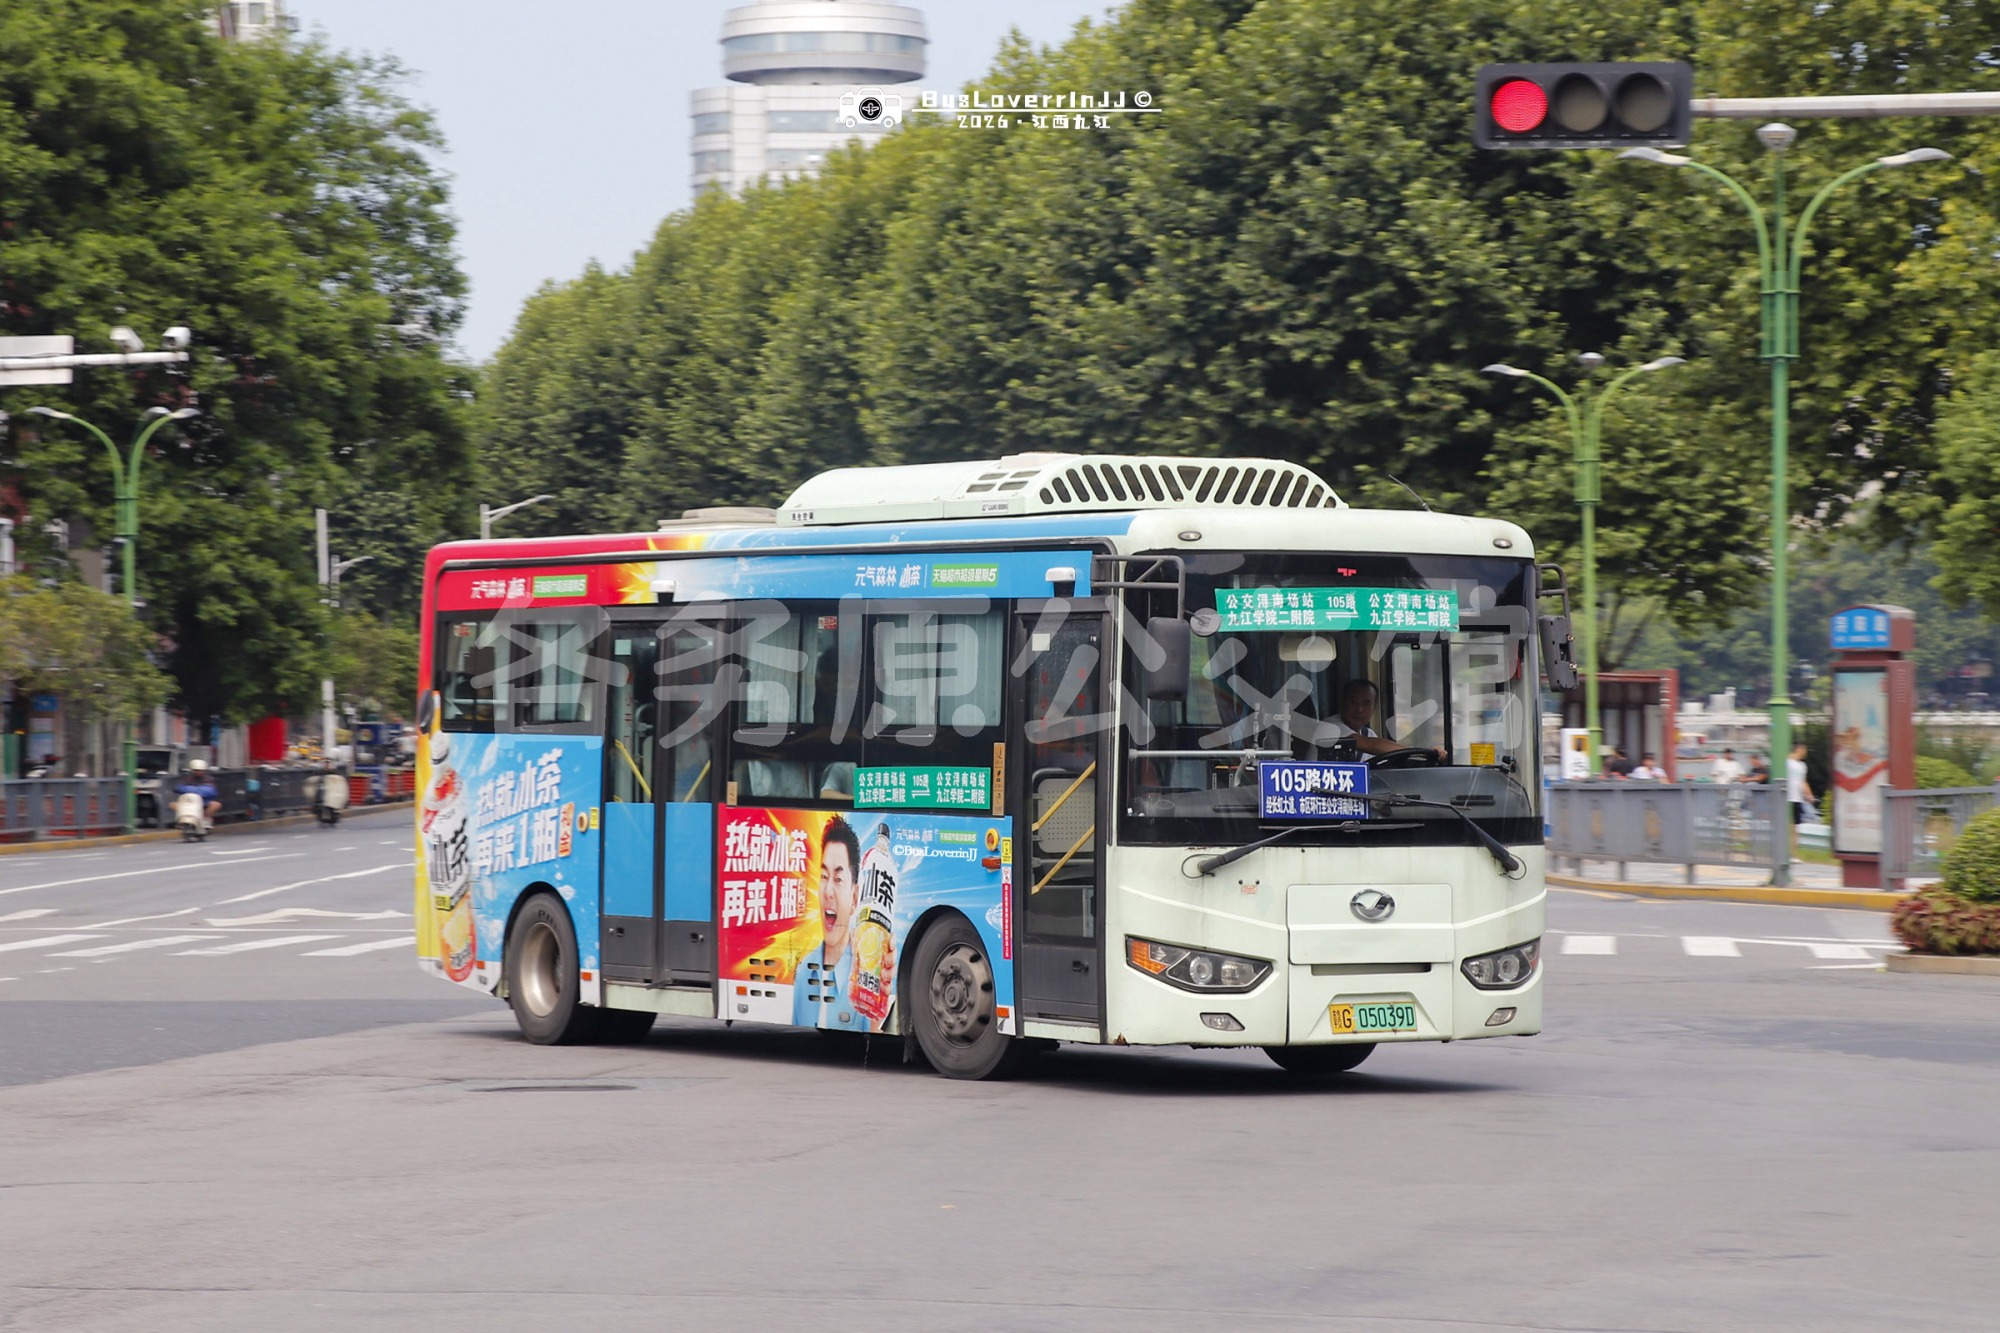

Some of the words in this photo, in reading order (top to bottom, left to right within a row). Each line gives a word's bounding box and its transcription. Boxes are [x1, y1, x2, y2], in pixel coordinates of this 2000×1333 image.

[854, 565, 897, 588] 元气森林
[1226, 592, 1315, 609] 公交浔南场站
[1369, 592, 1450, 609] 公交浔南场站
[1227, 609, 1316, 626] 九江学院二附院
[1370, 609, 1451, 627] 九江学院二附院
[477, 748, 564, 830] 热就冰茶
[858, 771, 906, 787] 公交浔南场站
[936, 771, 986, 788] 公交浔南场站
[1270, 768, 1355, 793] 105路外环
[474, 806, 560, 877] 再来1瓶
[723, 815, 808, 874] 热就冰茶
[721, 875, 798, 929] 再来1瓶
[1358, 1006, 1415, 1029] 05039D
